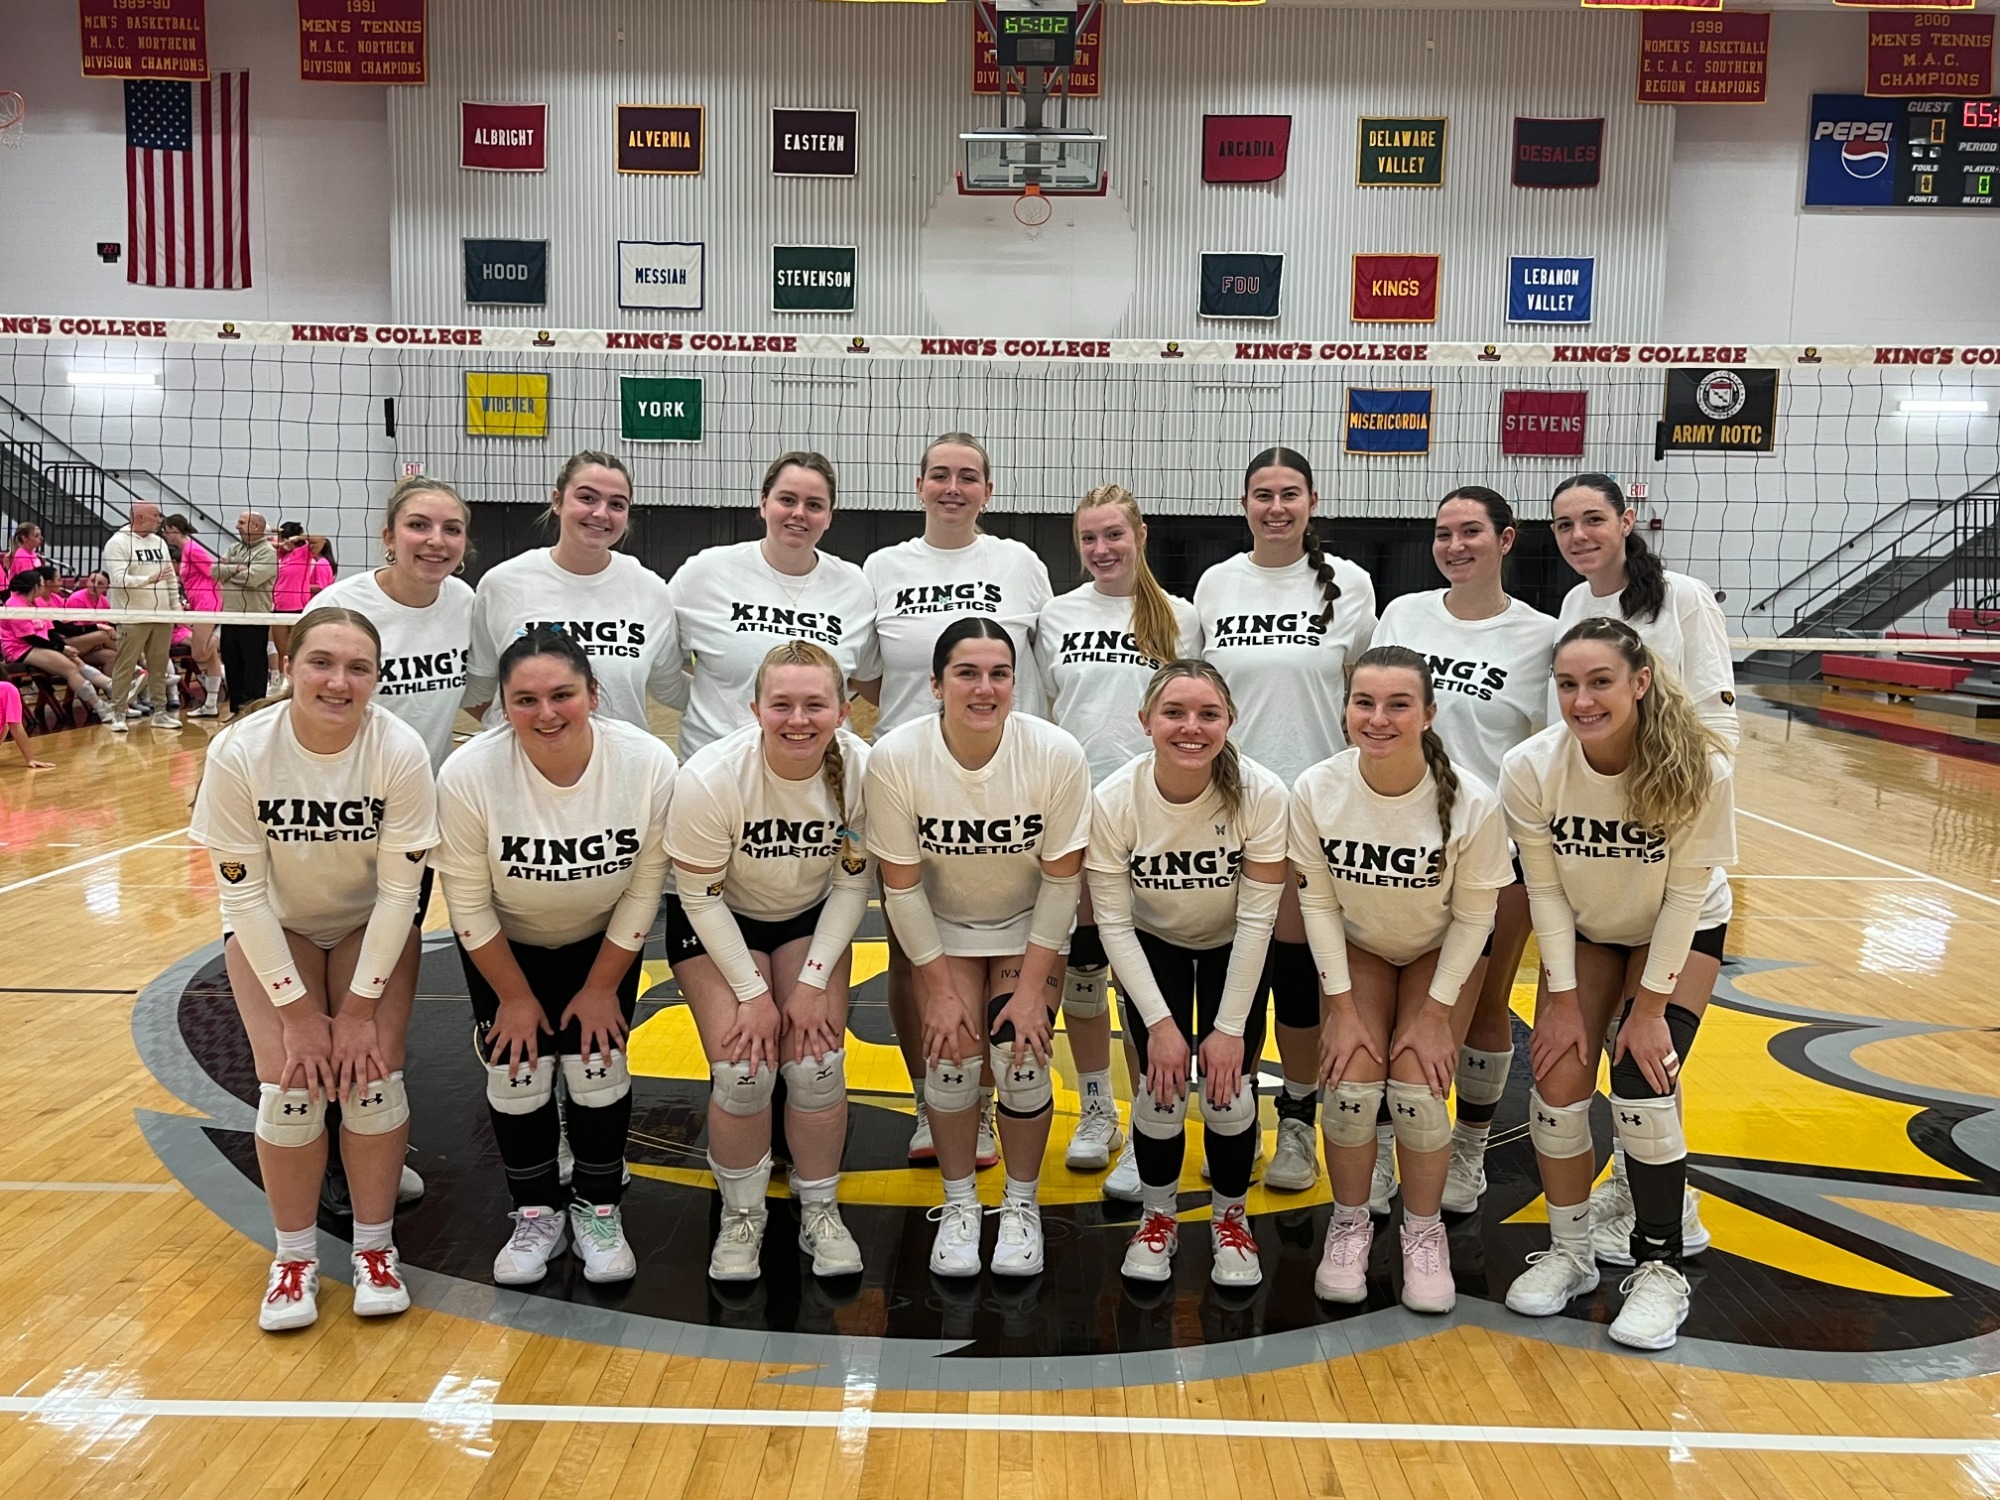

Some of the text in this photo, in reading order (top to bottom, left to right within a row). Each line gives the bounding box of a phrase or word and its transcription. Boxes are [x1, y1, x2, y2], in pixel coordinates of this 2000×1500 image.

[347, 0, 376, 13] 1991
[85, 16, 200, 31] MEN'S BASKETBALL
[302, 19, 421, 34] MEN'S TENNIS
[1005, 16, 1068, 34] 65:02
[1690, 20, 1723, 34] 1998
[1914, 14, 1951, 27] 2000
[138, 36, 196, 51] NORTHERN
[358, 40, 414, 54] NORTHERN
[1644, 39, 1766, 54] WOMEN'S BASKETBALL
[1871, 33, 1992, 48] MEN'S TENNIS
[84, 55, 205, 72] DIVISION CHAMPIONS
[303, 59, 421, 75] DIVISION CHAMPIONS
[1705, 60, 1763, 74] SOUTHERN
[1645, 79, 1760, 94] REGION CHAMPIONS
[1880, 72, 1980, 87] CHAMPIONS
[1907, 101, 1952, 113] GUEST
[1963, 102, 2000, 128] 65:
[474, 127, 534, 147] ALBRIGHT
[628, 130, 691, 149] ALVERNIA
[1368, 130, 1436, 148] DELAWARE
[1814, 121, 1893, 142] PEPSI
[1930, 118, 1947, 144] 0
[784, 133, 845, 152] EASTERN
[1218, 140, 1275, 158] ARCADIA
[1958, 142, 1998, 152] PERIOD
[1519, 145, 1597, 163] DESALES
[1377, 156, 1425, 174] VALLEY
[1912, 164, 1939, 172] FOULS
[1920, 174, 1934, 194] 0
[1978, 174, 1991, 194] 0
[1908, 195, 1939, 204] POINTS
[1962, 196, 1993, 204] MATCH
[482, 263, 529, 281] HOOD
[634, 267, 687, 286] MESSIAH
[777, 269, 852, 288] STEVENSON
[1524, 268, 1580, 286] LEBANON
[1221, 275, 1261, 294] FDU
[1371, 278, 1420, 297] KING'S
[1526, 294, 1575, 312] VALLEY
[59, 318, 167, 337] COLLEGE
[291, 325, 483, 345] KING'S COLLEGE
[606, 332, 797, 352] KING'S COLLEGE
[920, 338, 1111, 358] KING'S COLLEGE
[1235, 342, 1428, 361] KING'S COLLEGE
[1552, 345, 1748, 363] KING'S COLLEGE
[1873, 347, 1954, 365] KING'S
[480, 396, 535, 414] WIDENER
[637, 400, 686, 418] YORK
[1350, 413, 1429, 431] MISERICORDIA
[1505, 415, 1582, 433] STEVENS
[1672, 425, 1763, 445] ARMY ROTC
[405, 464, 421, 475] EXIT
[1630, 483, 1646, 496] EXIT
[135, 549, 164, 561] FDU
[894, 581, 1003, 610] KING'S
[896, 600, 998, 617] ATHLETICS
[729, 602, 843, 636] KING'S
[1214, 611, 1328, 639] KING'S
[735, 622, 840, 647] ATHLETICS
[1216, 633, 1321, 649] ATHLETICS
[584, 644, 640, 660] ETICS
[1061, 651, 1160, 671] ATHLETICS
[1433, 677, 1494, 702] ETICS
[266, 826, 378, 842] ATHLETIC
[917, 812, 1043, 844] KING'S
[499, 828, 641, 866] KING'S
[921, 838, 1036, 855] ATHLETICS
[506, 857, 633, 883] ATHLETICS
[1327, 863, 1442, 889] THLETICS
